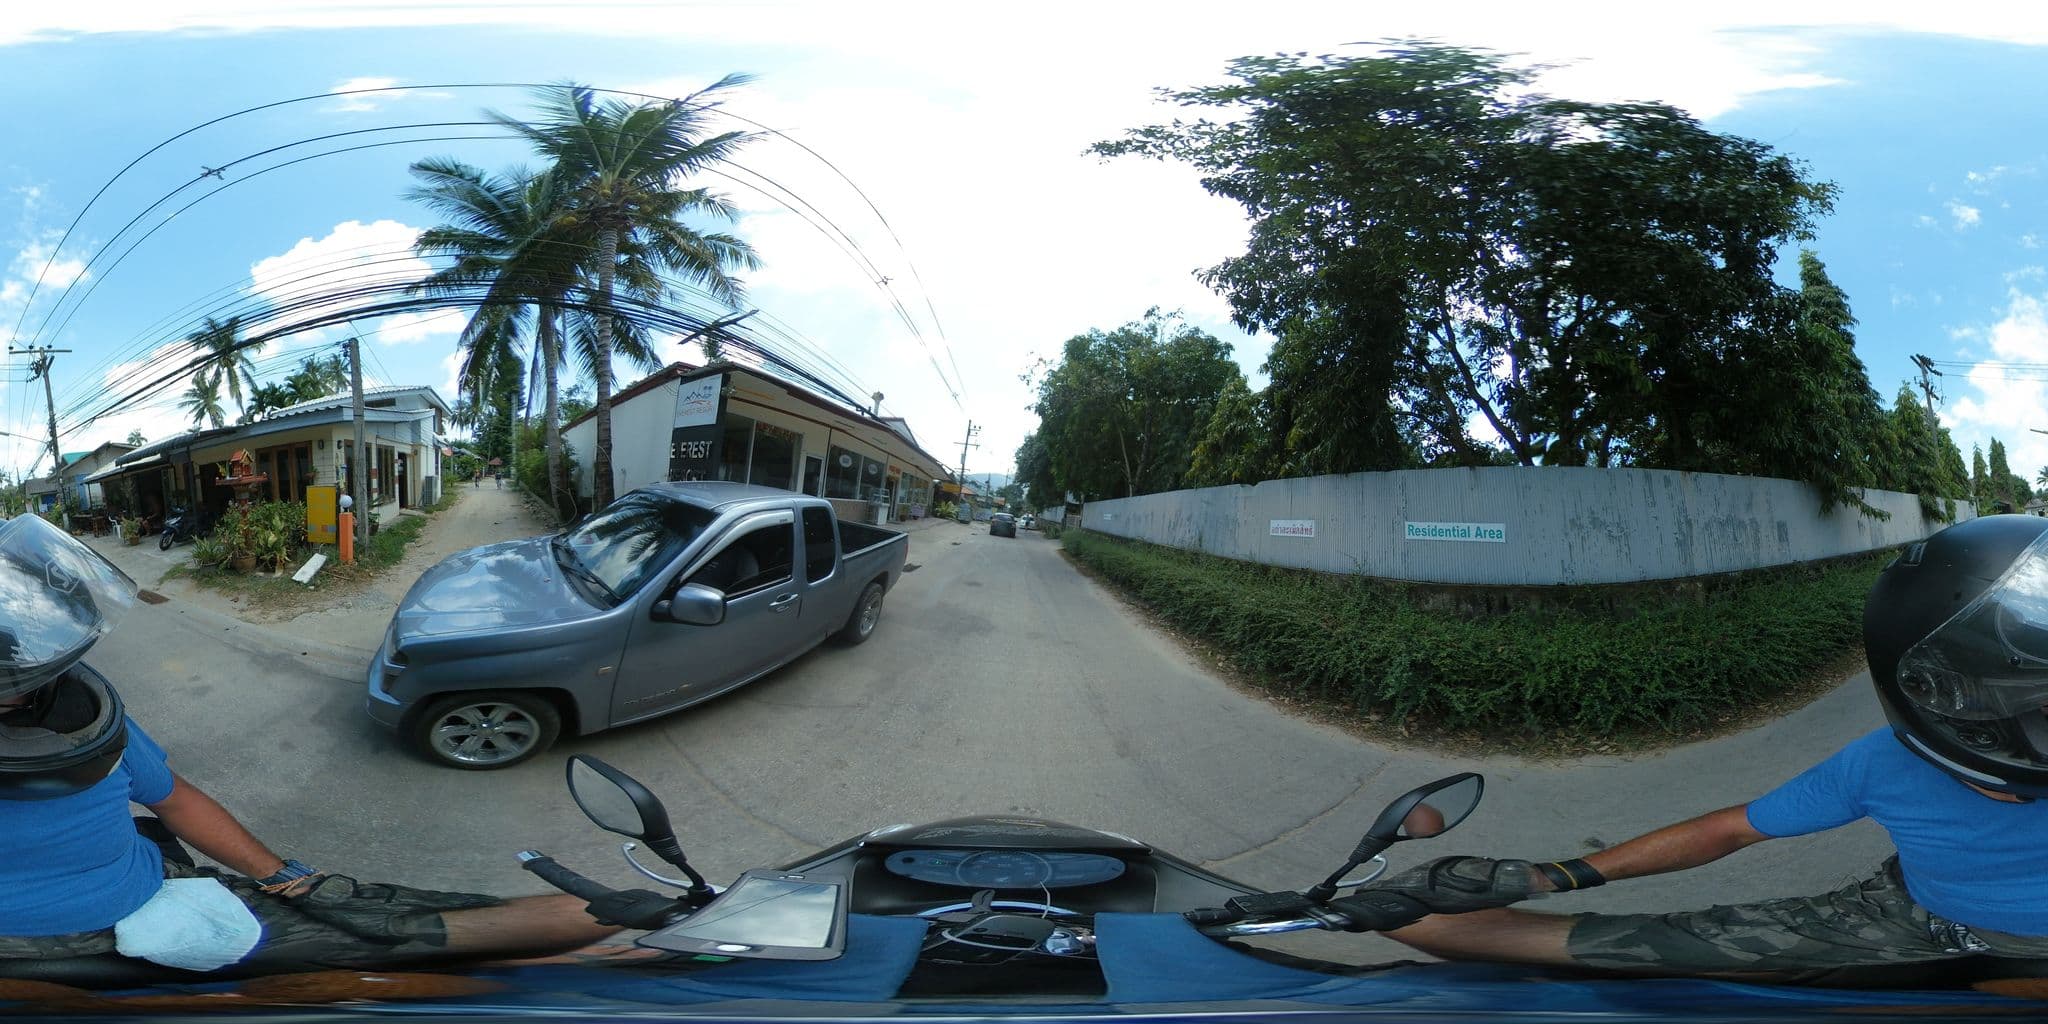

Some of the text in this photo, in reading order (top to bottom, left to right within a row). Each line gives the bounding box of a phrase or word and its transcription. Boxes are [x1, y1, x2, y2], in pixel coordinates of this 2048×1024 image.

[670, 440, 713, 459] EEREST
[1407, 524, 1503, 539] Residential Area
